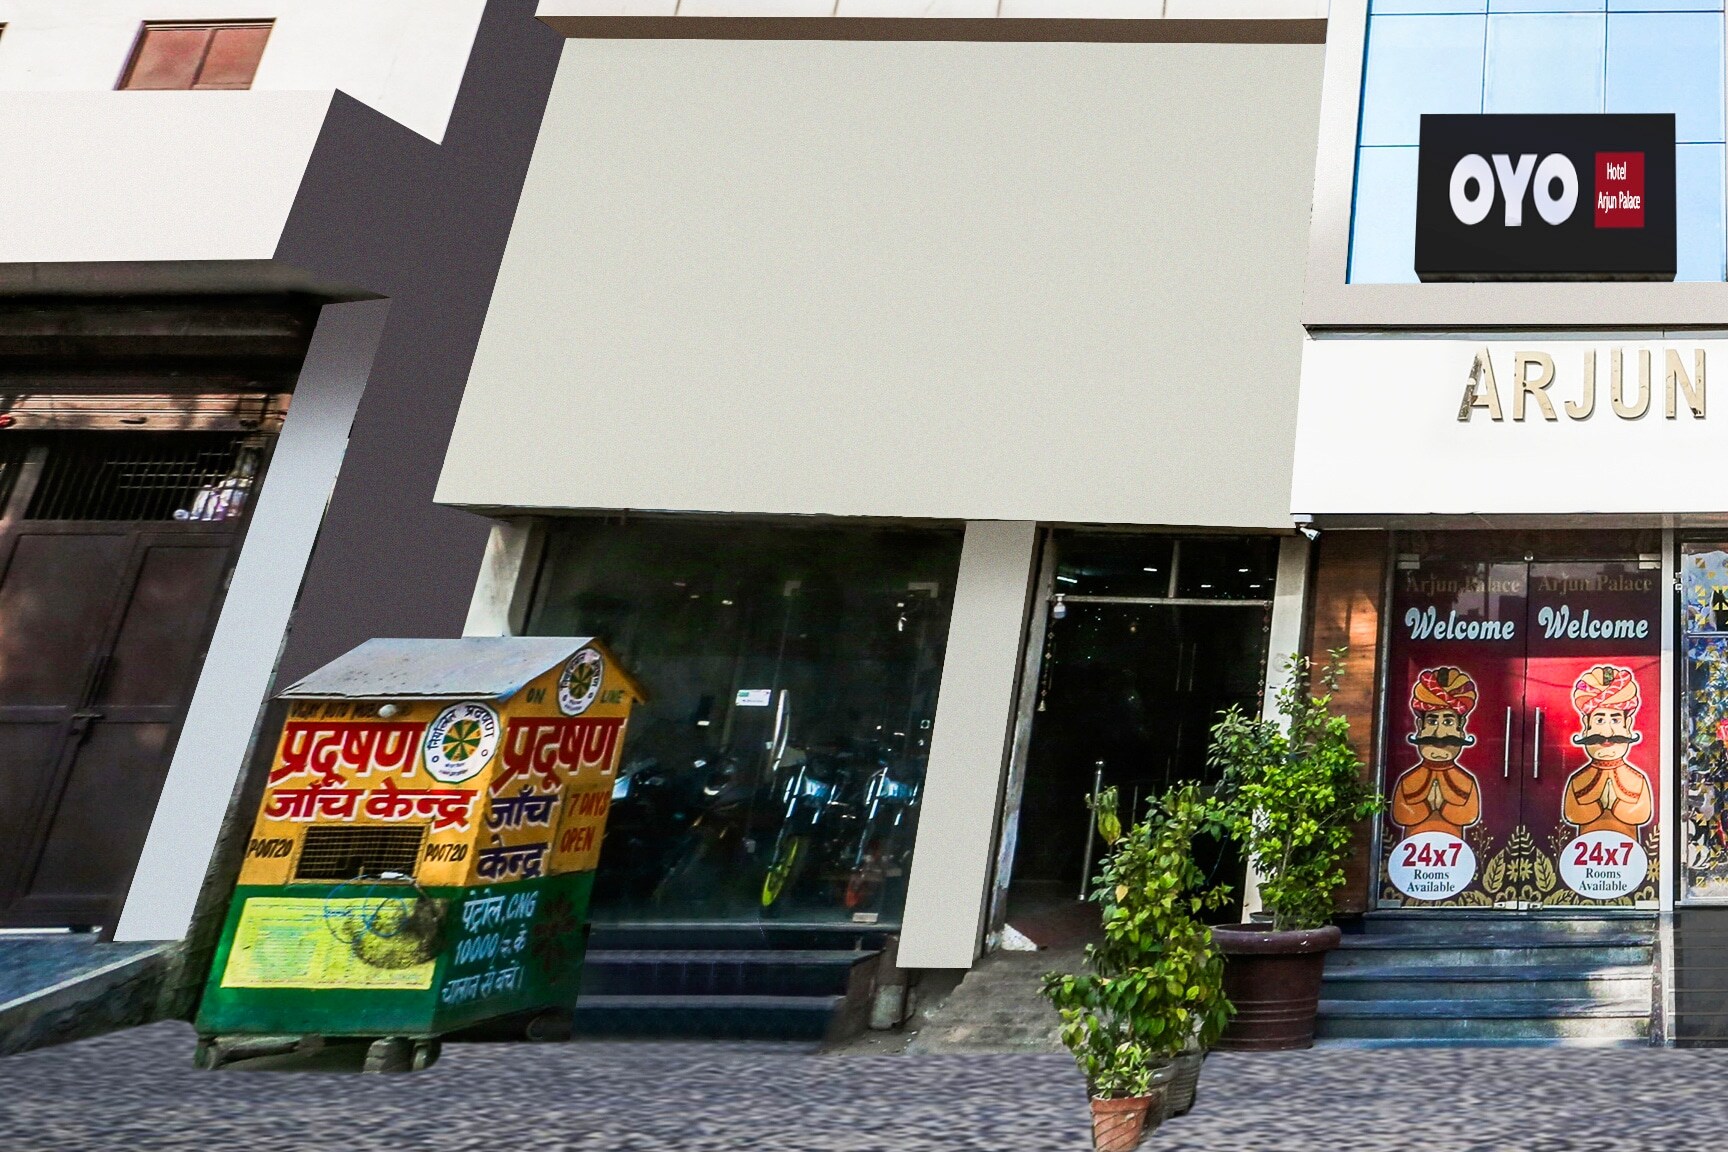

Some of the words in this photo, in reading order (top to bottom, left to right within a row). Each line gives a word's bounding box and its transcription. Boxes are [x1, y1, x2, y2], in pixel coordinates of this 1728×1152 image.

[1606, 161, 1627, 180] Hotel
[1449, 153, 1578, 226] OYO
[1597, 191, 1617, 214] Arjun
[1618, 190, 1641, 210] Palace
[1456, 346, 1706, 422] ARJUN
[1406, 575, 1458, 596] Arjun
[1459, 575, 1521, 593] Palace
[1538, 573, 1591, 595] Arjun
[1596, 575, 1653, 593] Palace
[1405, 605, 1515, 640] Welcome
[1538, 604, 1649, 639] Welcome
[268, 721, 429, 787] प्रदूषण
[489, 717, 627, 797] प्रदूषण
[365, 777, 481, 833] केन्द्र
[485, 783, 561, 832] जाँच
[560, 826, 596, 854] OPEN
[1402, 843, 1463, 867] 24x7
[1573, 842, 1634, 866] 24x7
[1413, 869, 1450, 880] Rooms
[1585, 868, 1622, 879] Rooms
[1406, 882, 1456, 893] Available
[1578, 880, 1628, 892] Available
